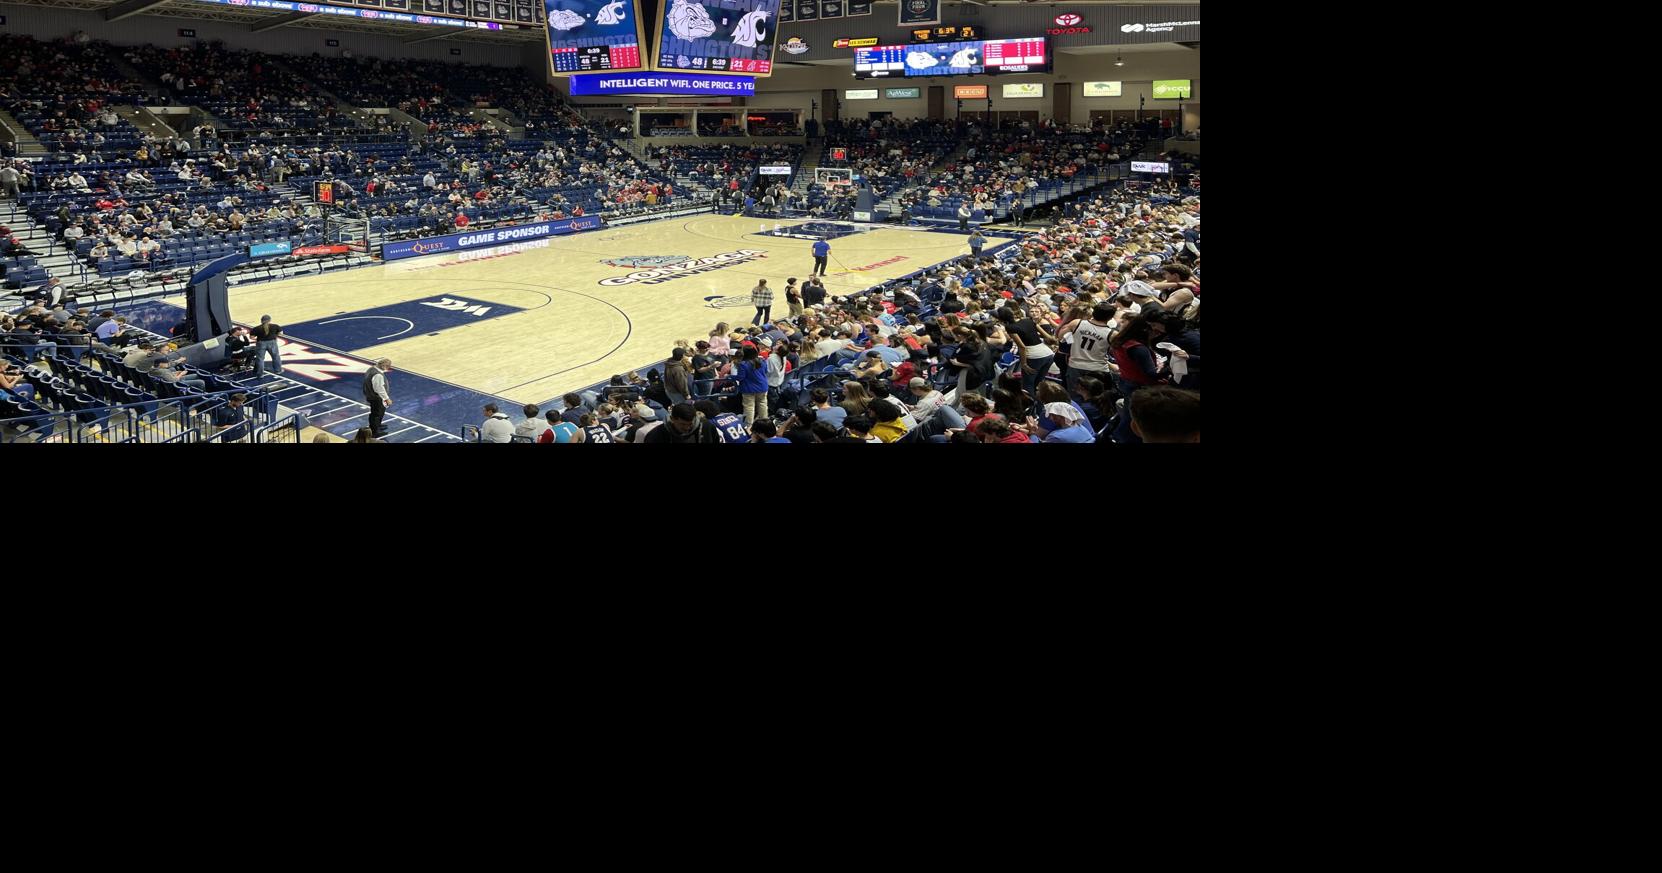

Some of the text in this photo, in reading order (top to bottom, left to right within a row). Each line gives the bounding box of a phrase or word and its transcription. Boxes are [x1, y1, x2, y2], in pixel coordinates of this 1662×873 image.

[1046, 27, 1090, 35] TOYOTA
[691, 57, 703, 66] 48
[712, 58, 727, 66] 6:39
[734, 60, 744, 68] 21
[599, 78, 669, 89] INTELLIGENT
[670, 79, 691, 89] WIFI.
[692, 80, 710, 89] ONE
[711, 81, 736, 90] PRICE.
[736, 82, 742, 90] 5
[887, 89, 913, 97] AgWest
[569, 220, 592, 231] QUEST
[458, 225, 550, 246] GAME SPONSOR
[411, 241, 444, 254] QUEST
[598, 248, 768, 286] GONZAGA
[1080, 336, 1096, 351] 11
[563, 427, 572, 437] 1
[726, 423, 747, 440] 84
[592, 432, 610, 443] 22
